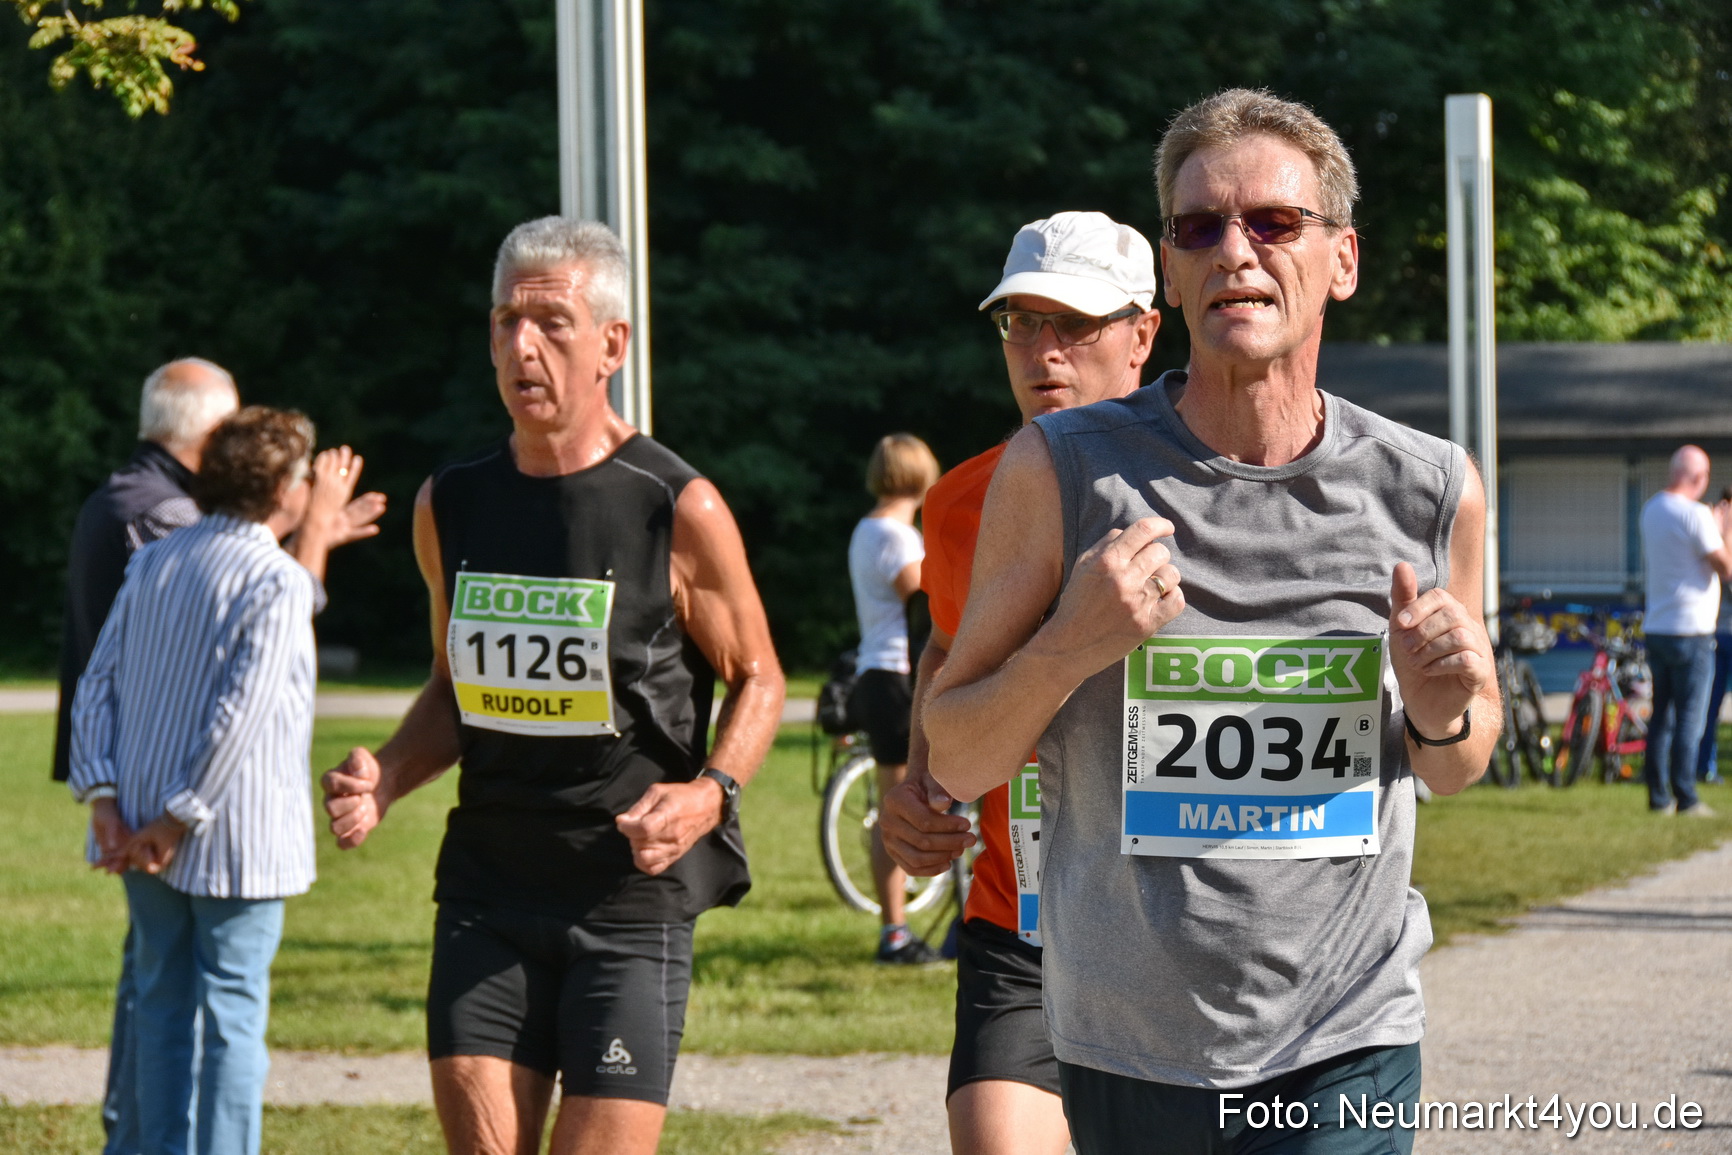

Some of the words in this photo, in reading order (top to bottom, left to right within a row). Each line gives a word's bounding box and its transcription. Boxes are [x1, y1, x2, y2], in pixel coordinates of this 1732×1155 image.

[462, 581, 595, 622] BOCK
[466, 631, 588, 682] 1126
[591, 642, 598, 651] B
[1146, 646, 1365, 696] BOCK
[481, 693, 573, 716] RUDOLF
[1359, 719, 1370, 731] B
[1155, 712, 1351, 782] 2034
[1178, 802, 1326, 832] MARTIN
[595, 1064, 638, 1075] odlo
